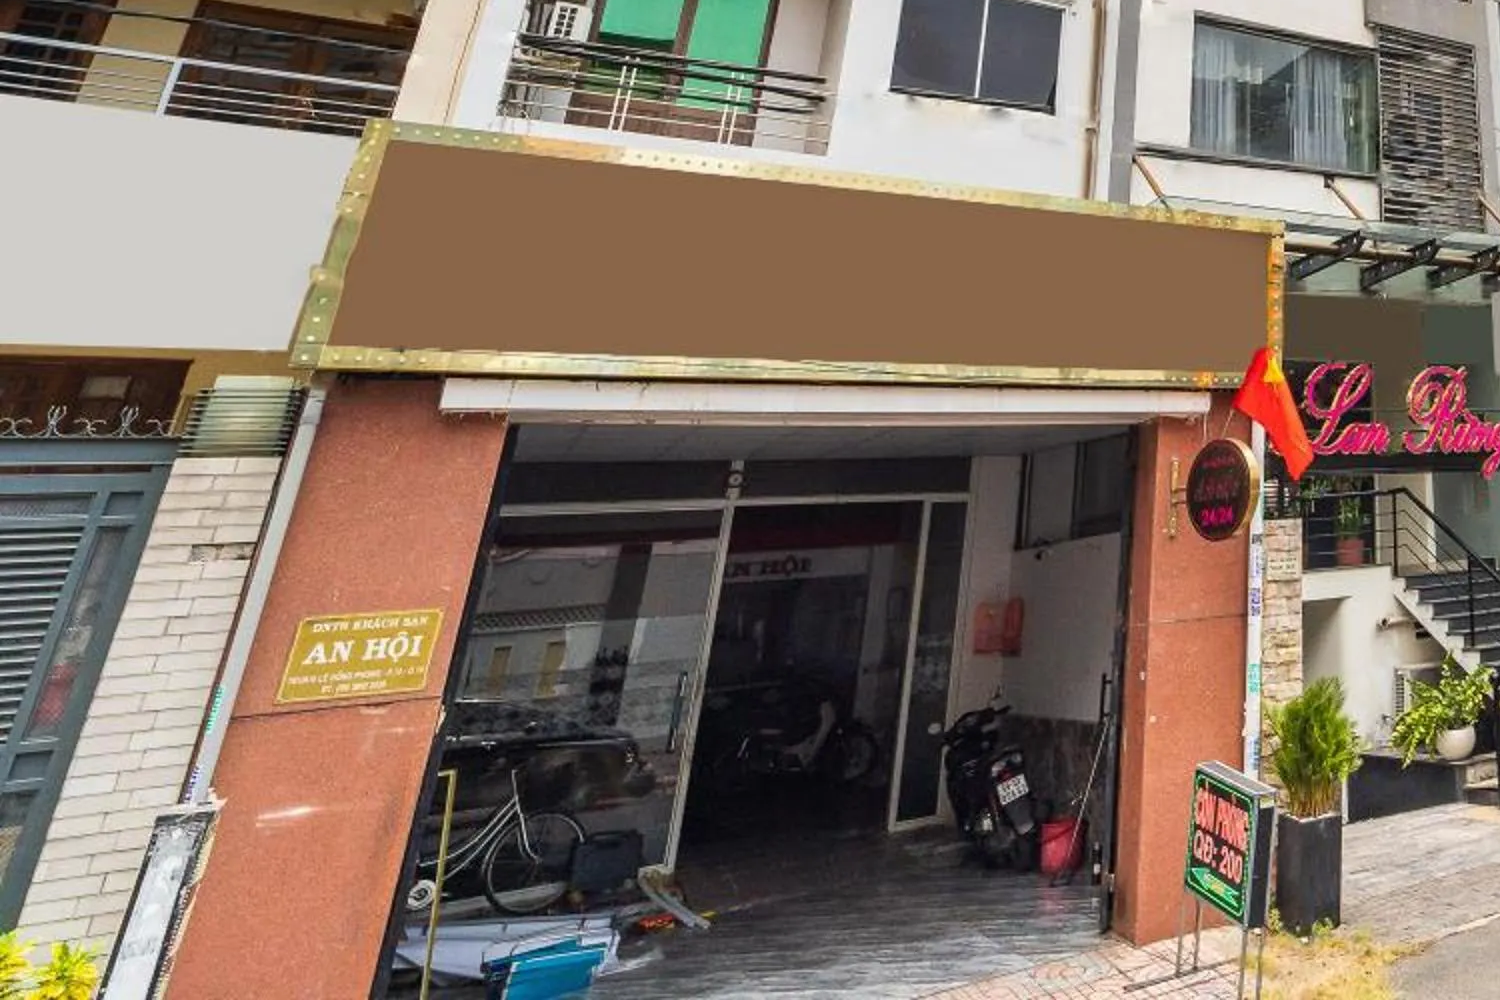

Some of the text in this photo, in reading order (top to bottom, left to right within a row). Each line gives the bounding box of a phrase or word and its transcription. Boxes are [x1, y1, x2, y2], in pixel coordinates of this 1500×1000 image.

[302, 631, 425, 666] AN HỘI
[1218, 845, 1244, 885] 200
